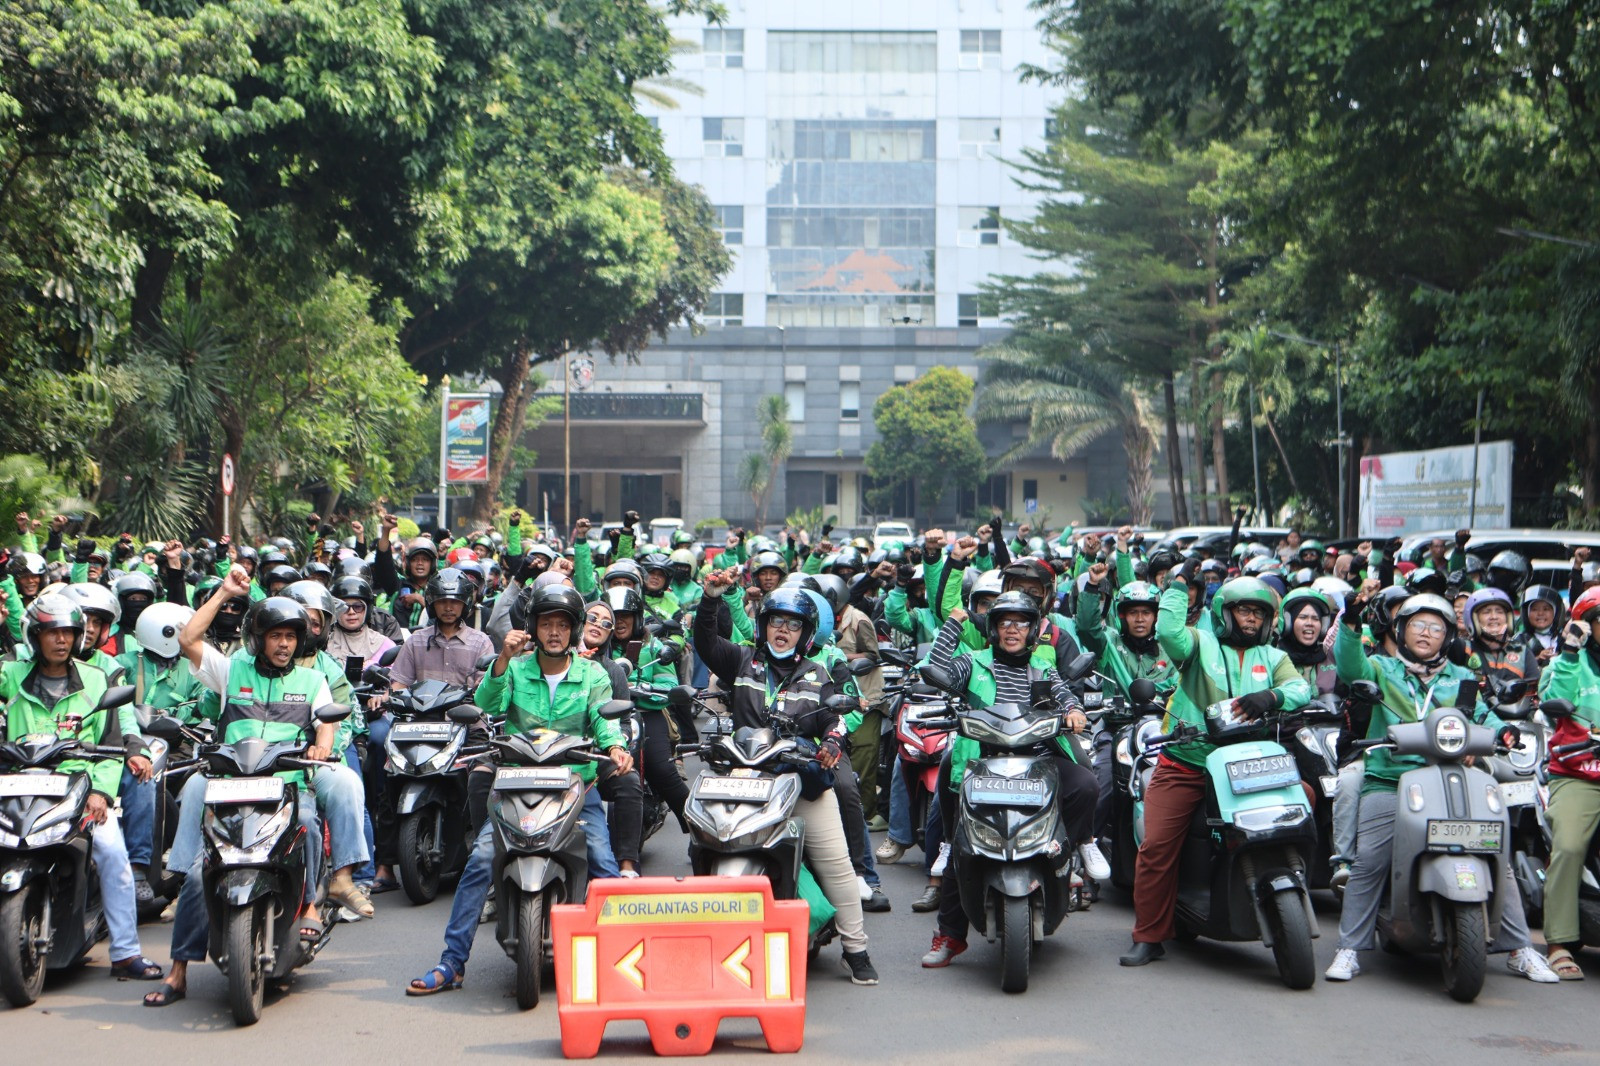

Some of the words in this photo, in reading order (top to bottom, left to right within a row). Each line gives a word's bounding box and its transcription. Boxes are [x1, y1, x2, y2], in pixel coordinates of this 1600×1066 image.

[284, 694, 306, 702] Grab
[1231, 765, 1239, 776] B
[1242, 762, 1269, 774] 4232
[1271, 756, 1291, 770] SVV
[1578, 760, 1600, 771] M
[209, 783, 216, 791] B
[716, 780, 743, 788] 5449
[748, 781, 767, 789] TAY
[974, 779, 982, 789] B
[986, 780, 1014, 790] 4410
[1020, 781, 1040, 791] UWB
[1431, 825, 1438, 835] B
[1444, 824, 1471, 836] 3099
[618, 902, 698, 915] KORLANTAS
[702, 900, 742, 913] POLRI
